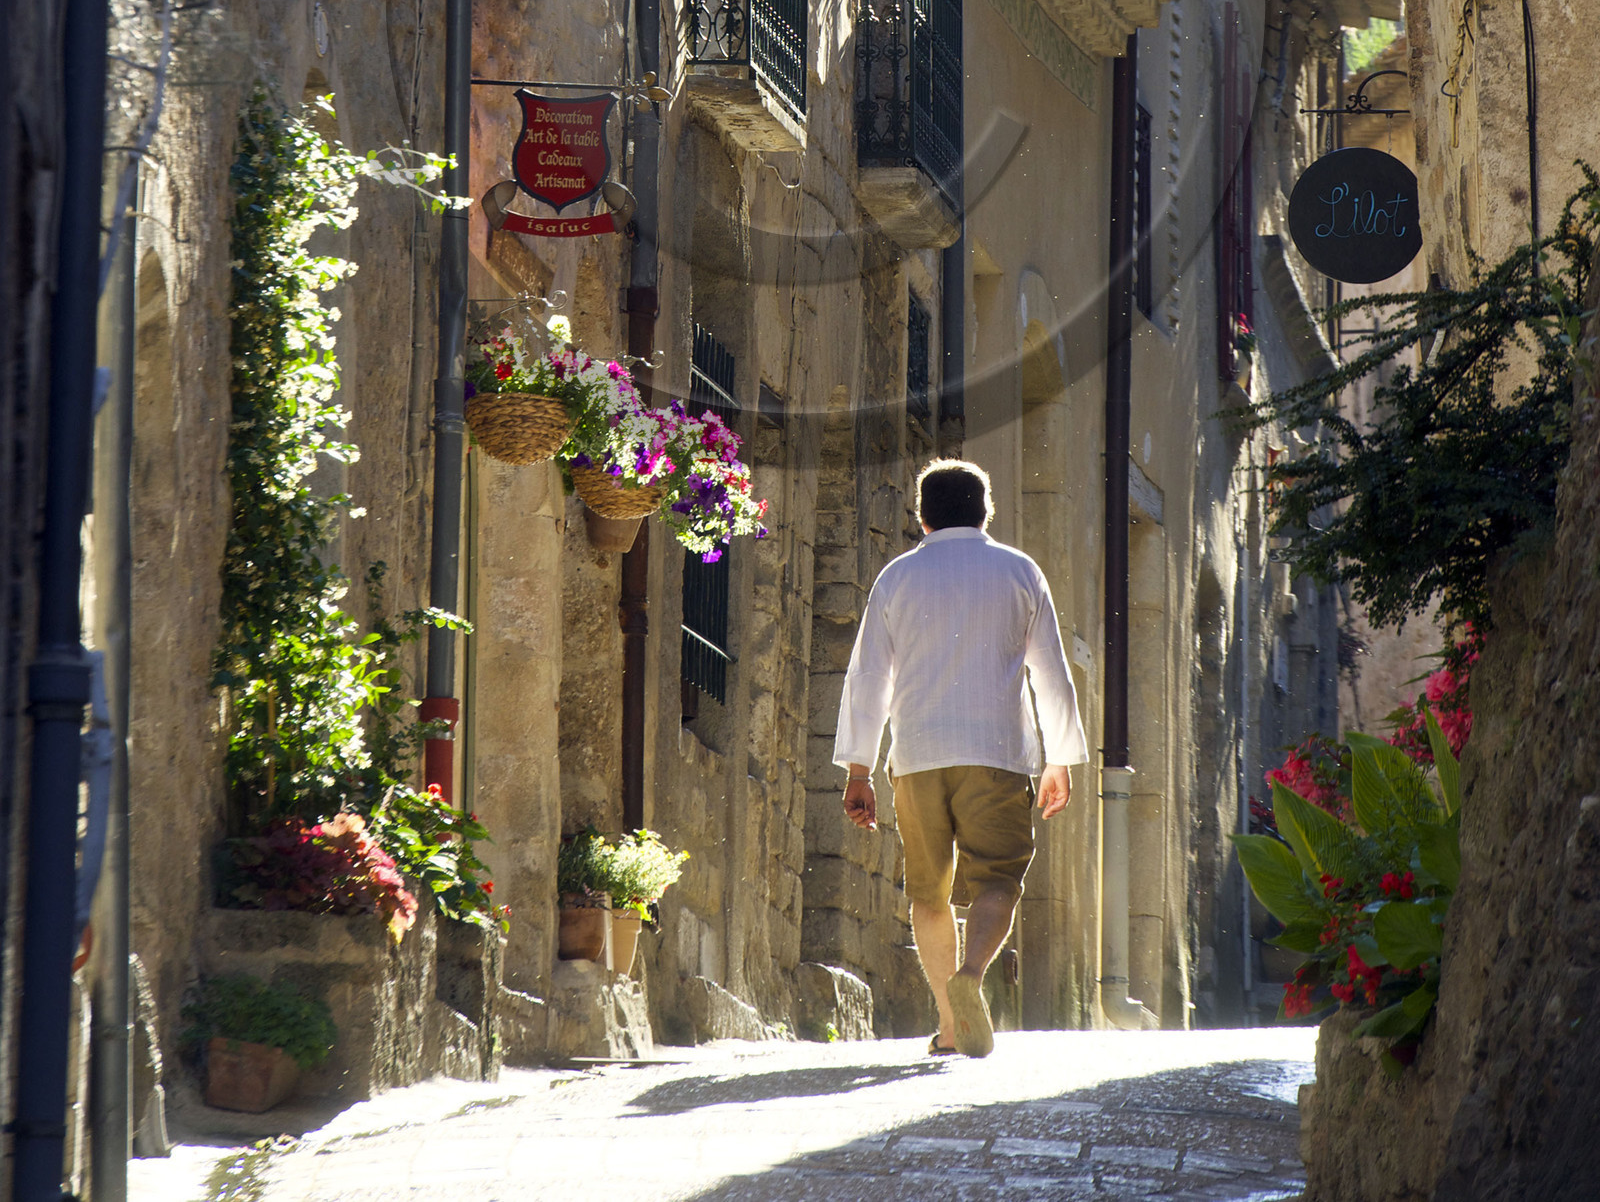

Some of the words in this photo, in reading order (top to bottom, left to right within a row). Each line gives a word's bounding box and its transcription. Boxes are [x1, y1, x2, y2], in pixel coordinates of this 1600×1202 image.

[534, 107, 593, 125] Décoration
[524, 129, 544, 144] Art
[546, 128, 557, 144] de
[560, 129, 571, 145] la
[538, 150, 583, 167] Cadeaux
[534, 172, 586, 189] Artisanat
[1315, 182, 1409, 238] L'ilot
